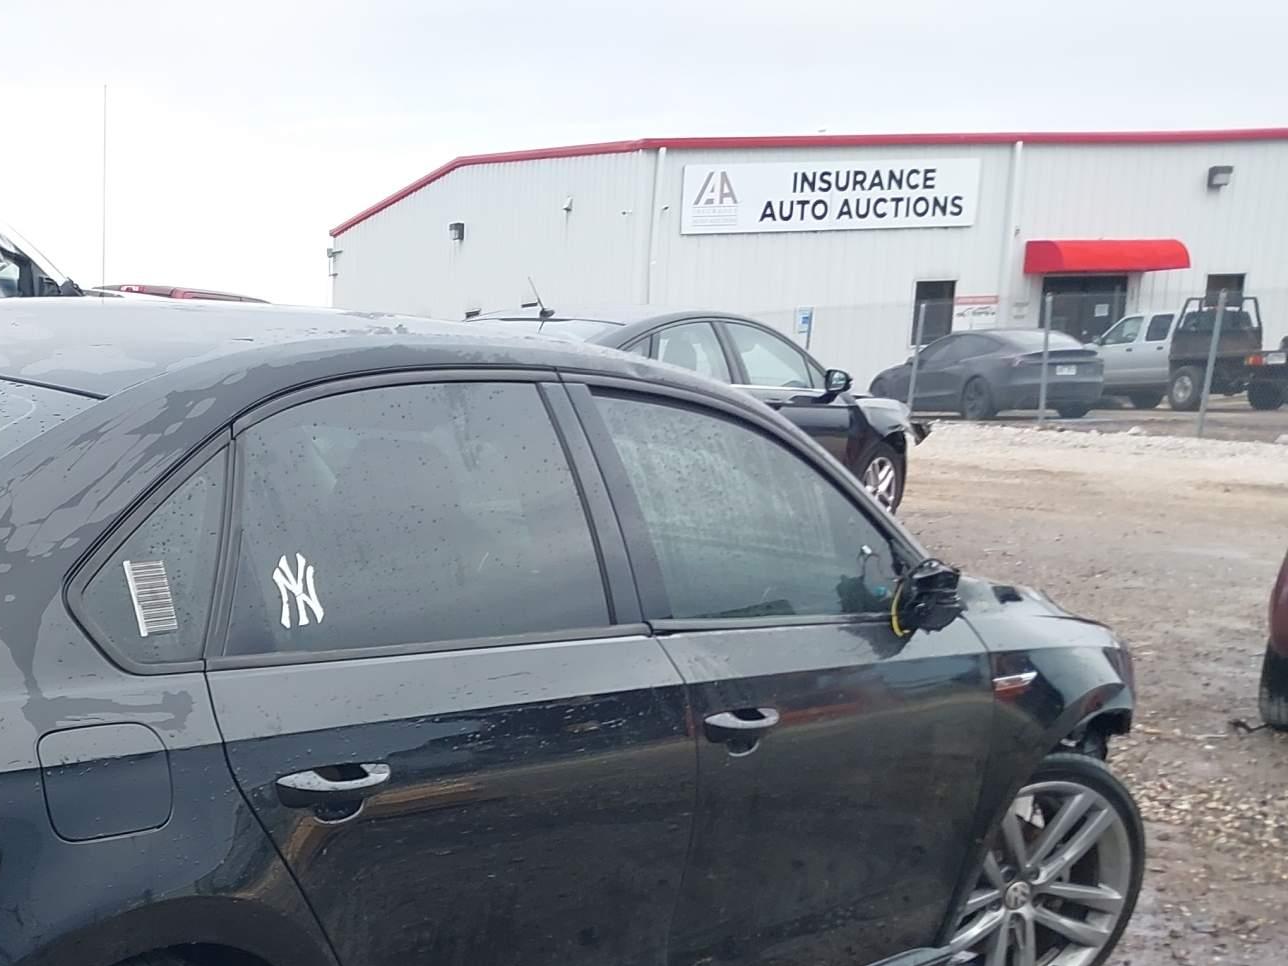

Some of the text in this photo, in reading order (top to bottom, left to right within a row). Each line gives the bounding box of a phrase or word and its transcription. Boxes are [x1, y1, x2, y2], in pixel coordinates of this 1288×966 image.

[792, 168, 937, 193] INSURANCE
[759, 196, 964, 222] AUTO AUCTIONS
[272, 552, 324, 629] NY
